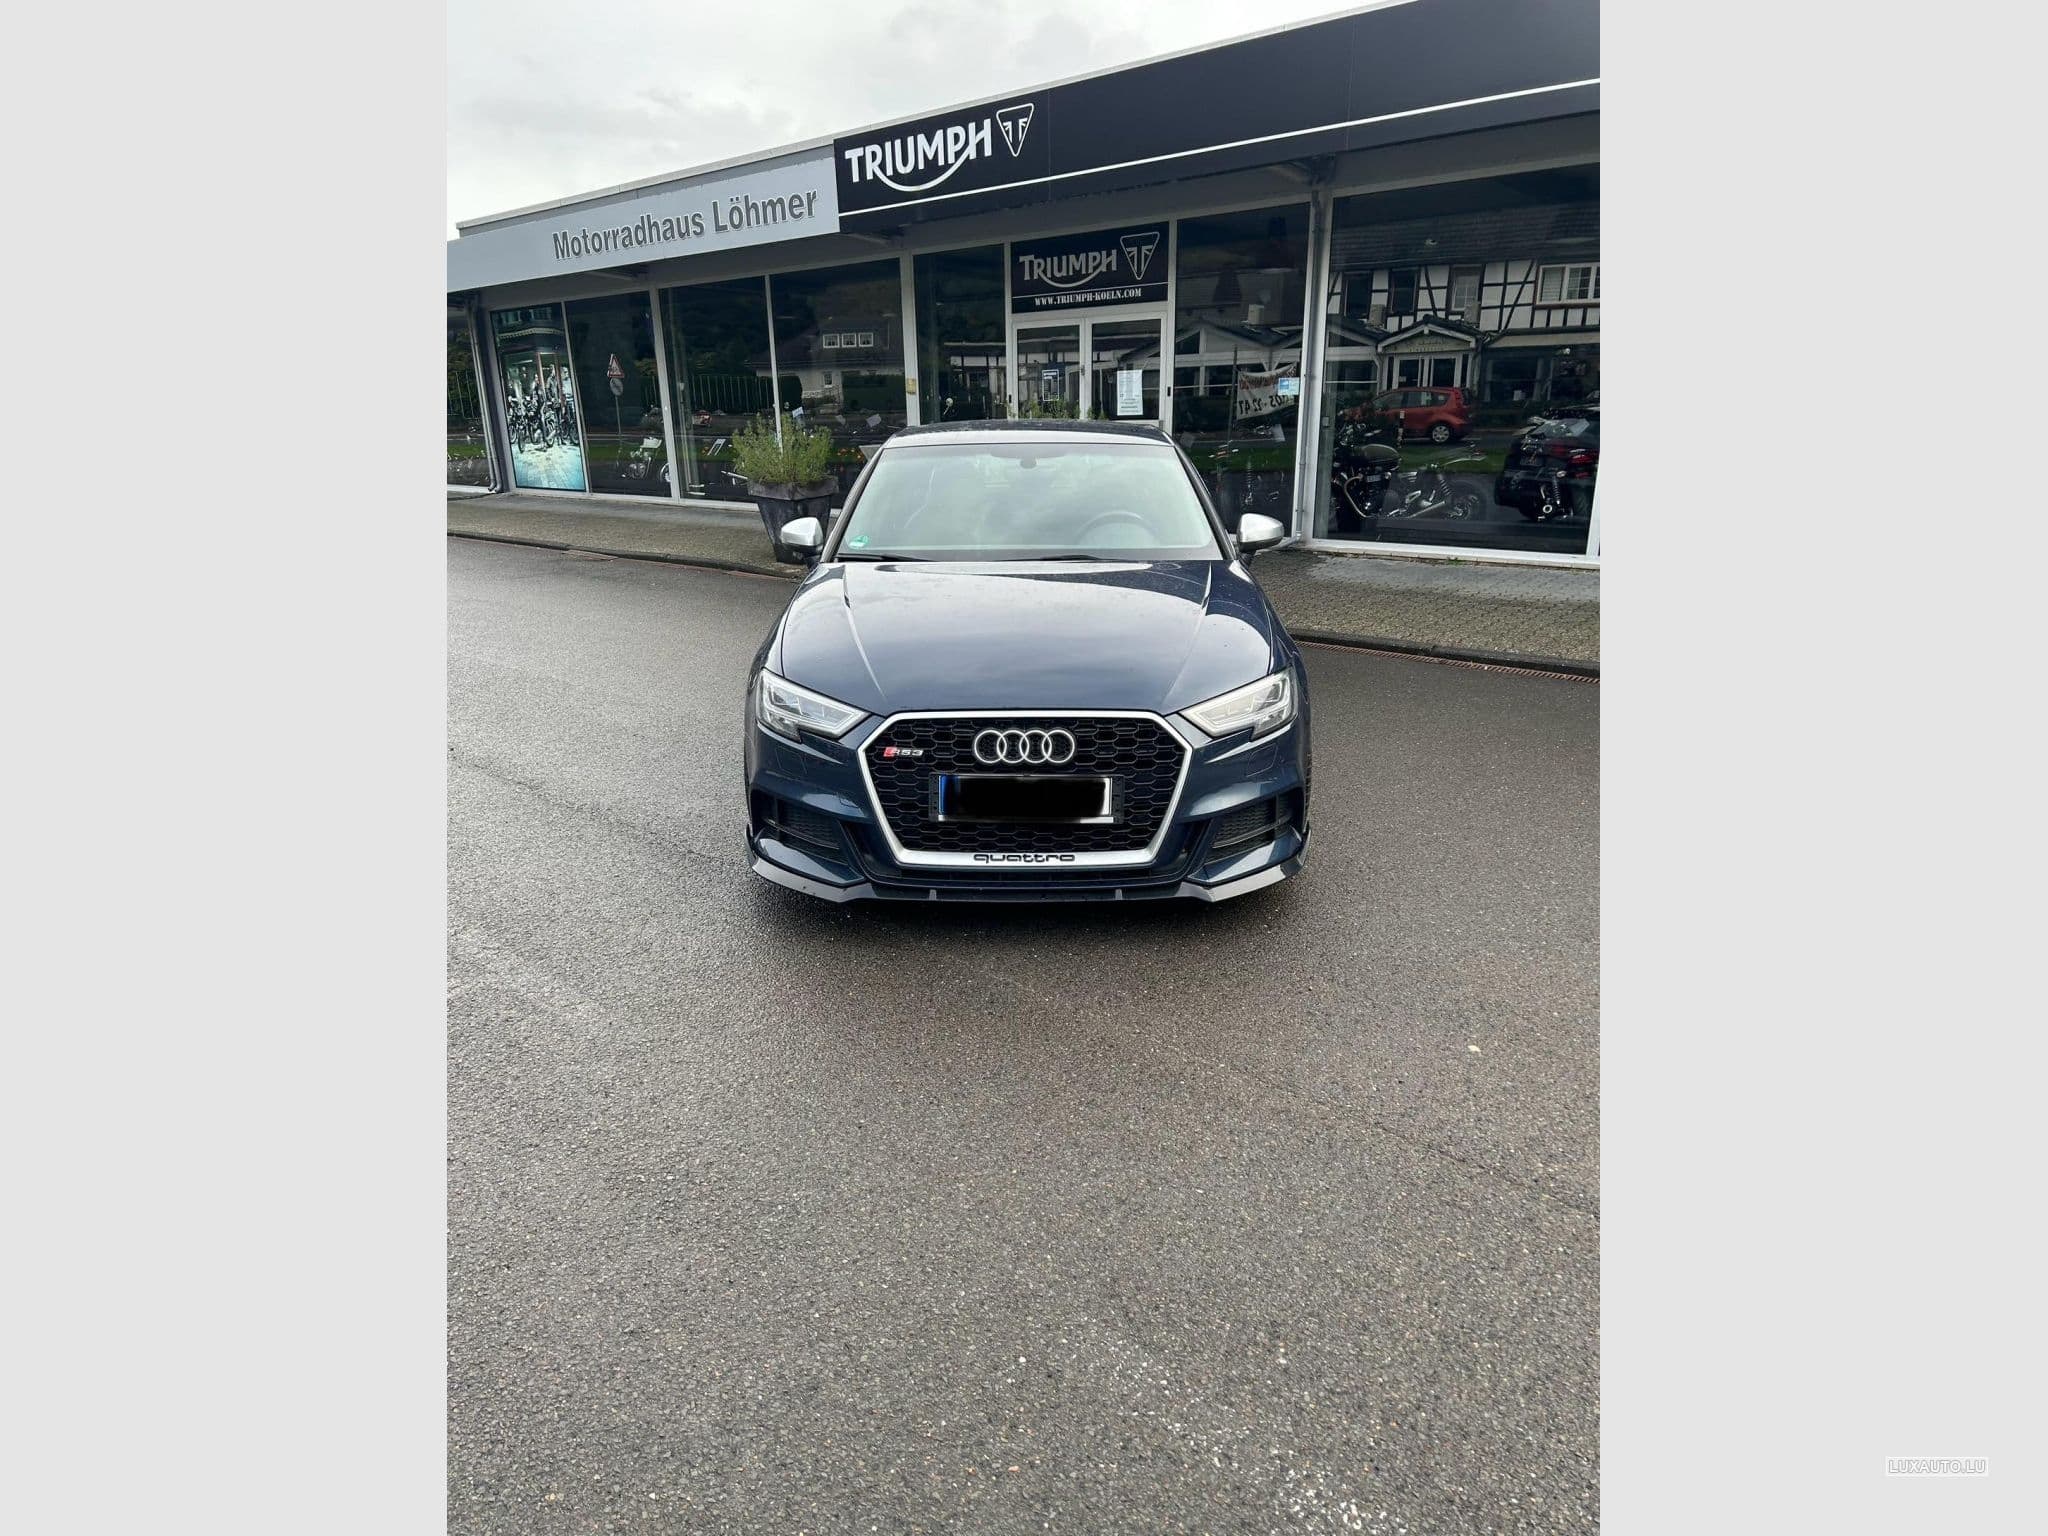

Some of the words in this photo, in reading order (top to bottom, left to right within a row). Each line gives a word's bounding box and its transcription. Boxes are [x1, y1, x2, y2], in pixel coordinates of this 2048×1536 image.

[845, 118, 993, 192] TRIUMPH
[552, 211, 705, 260] Motorradhaus
[712, 190, 818, 234] Löhmer
[1019, 249, 1118, 288] TRIUMPH
[1034, 287, 1142, 306] WWW.TRIUMPH-KOELN.COM
[886, 747, 924, 757] RS3
[973, 853, 1075, 864] quattro
